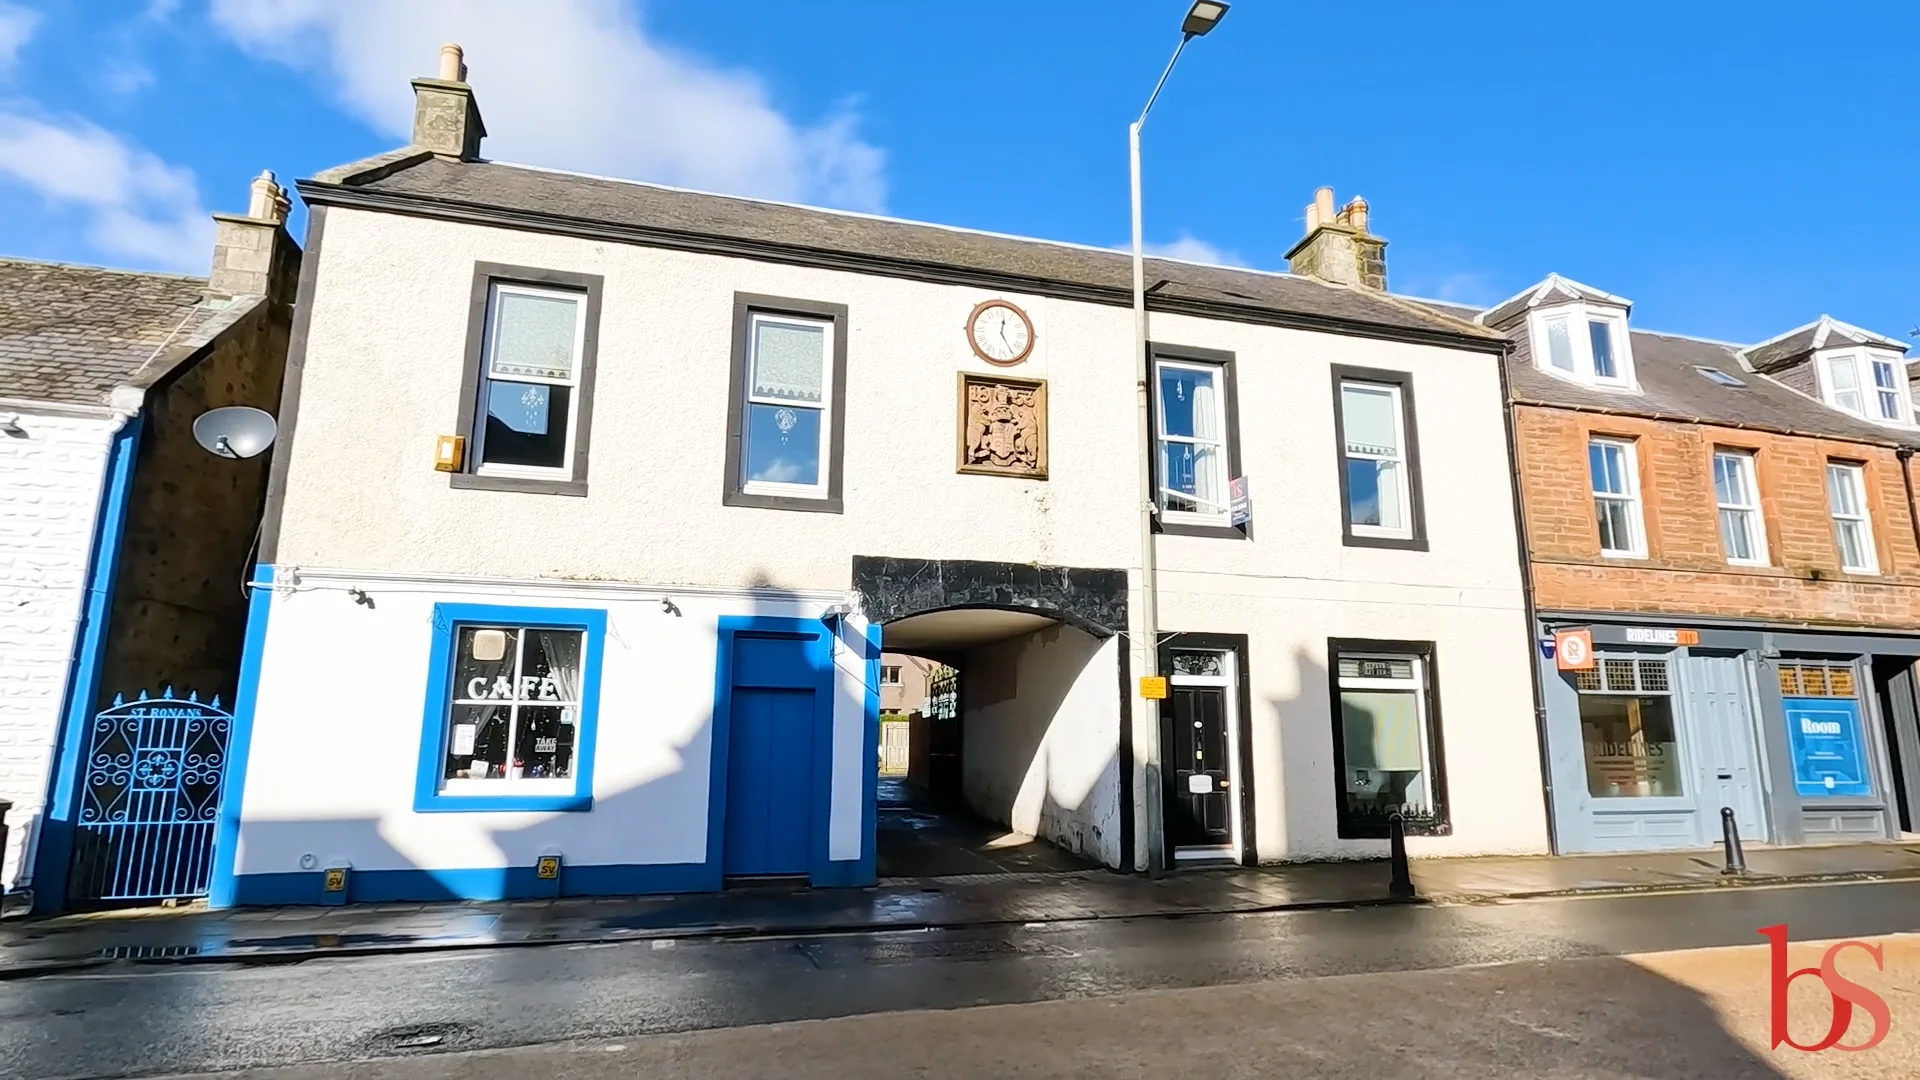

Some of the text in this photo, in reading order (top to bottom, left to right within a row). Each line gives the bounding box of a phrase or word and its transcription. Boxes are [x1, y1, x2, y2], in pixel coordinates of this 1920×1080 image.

[1626, 628, 1678, 644] RIDELINES
[467, 674, 558, 700] CAFÉ
[131, 707, 202, 717] ST RONANS
[1800, 717, 1841, 734] Room
[535, 737, 557, 746] TAKE
[541, 865, 556, 874] SV
[328, 877, 343, 887] SV
